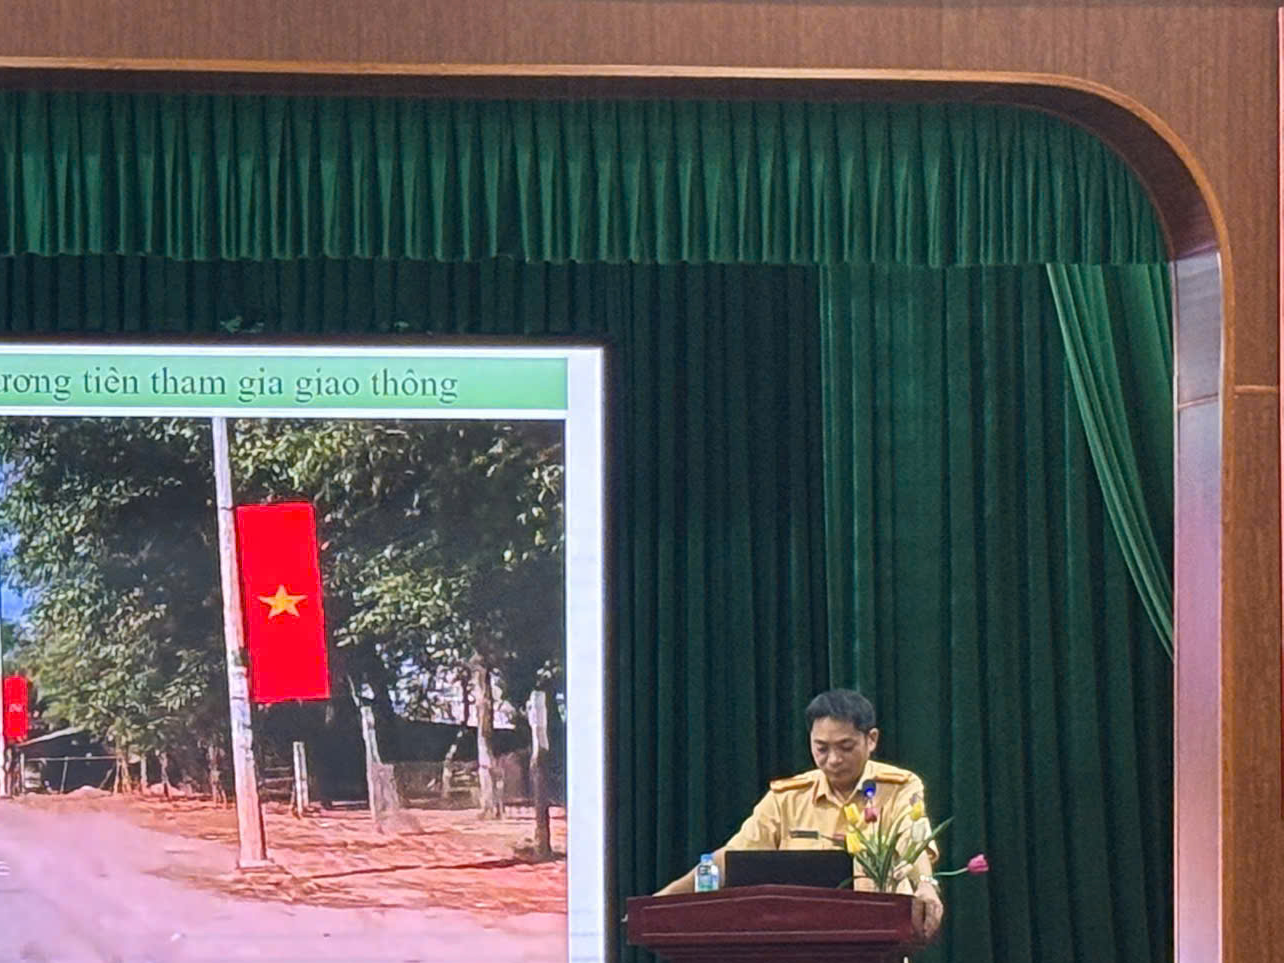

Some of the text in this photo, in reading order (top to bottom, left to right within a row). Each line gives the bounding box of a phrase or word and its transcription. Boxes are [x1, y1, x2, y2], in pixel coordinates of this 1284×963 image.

[151, 366, 227, 395] tham
[238, 367, 283, 403] gia
[295, 367, 360, 404] giao
[371, 368, 458, 404] thông
